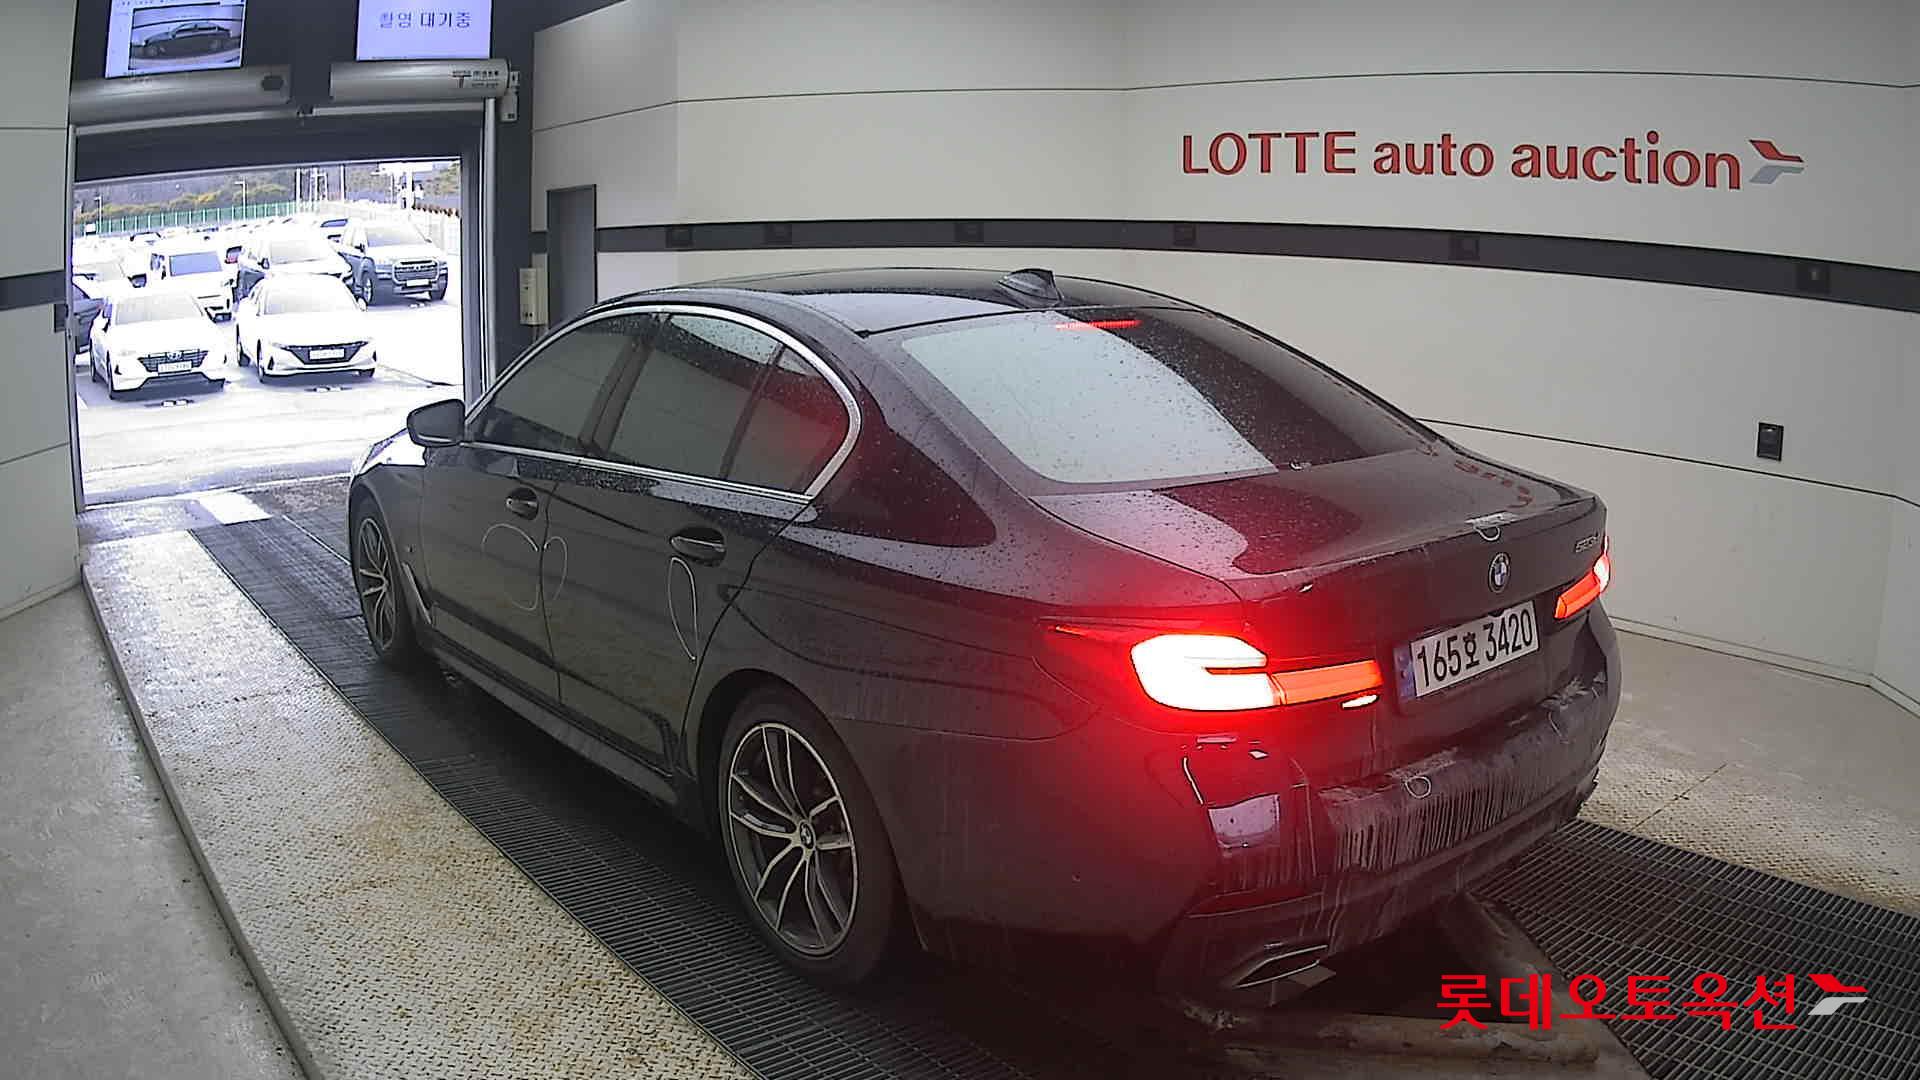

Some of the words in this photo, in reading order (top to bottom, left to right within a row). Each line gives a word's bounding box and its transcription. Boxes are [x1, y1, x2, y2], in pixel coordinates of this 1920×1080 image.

[420, 10, 472, 29] 대기중
[1183, 131, 1357, 174] LOTTE
[1374, 134, 1494, 177] auto
[1512, 131, 1742, 188] auction
[1417, 633, 1479, 687] 165호
[1483, 609, 1532, 662] 3420
